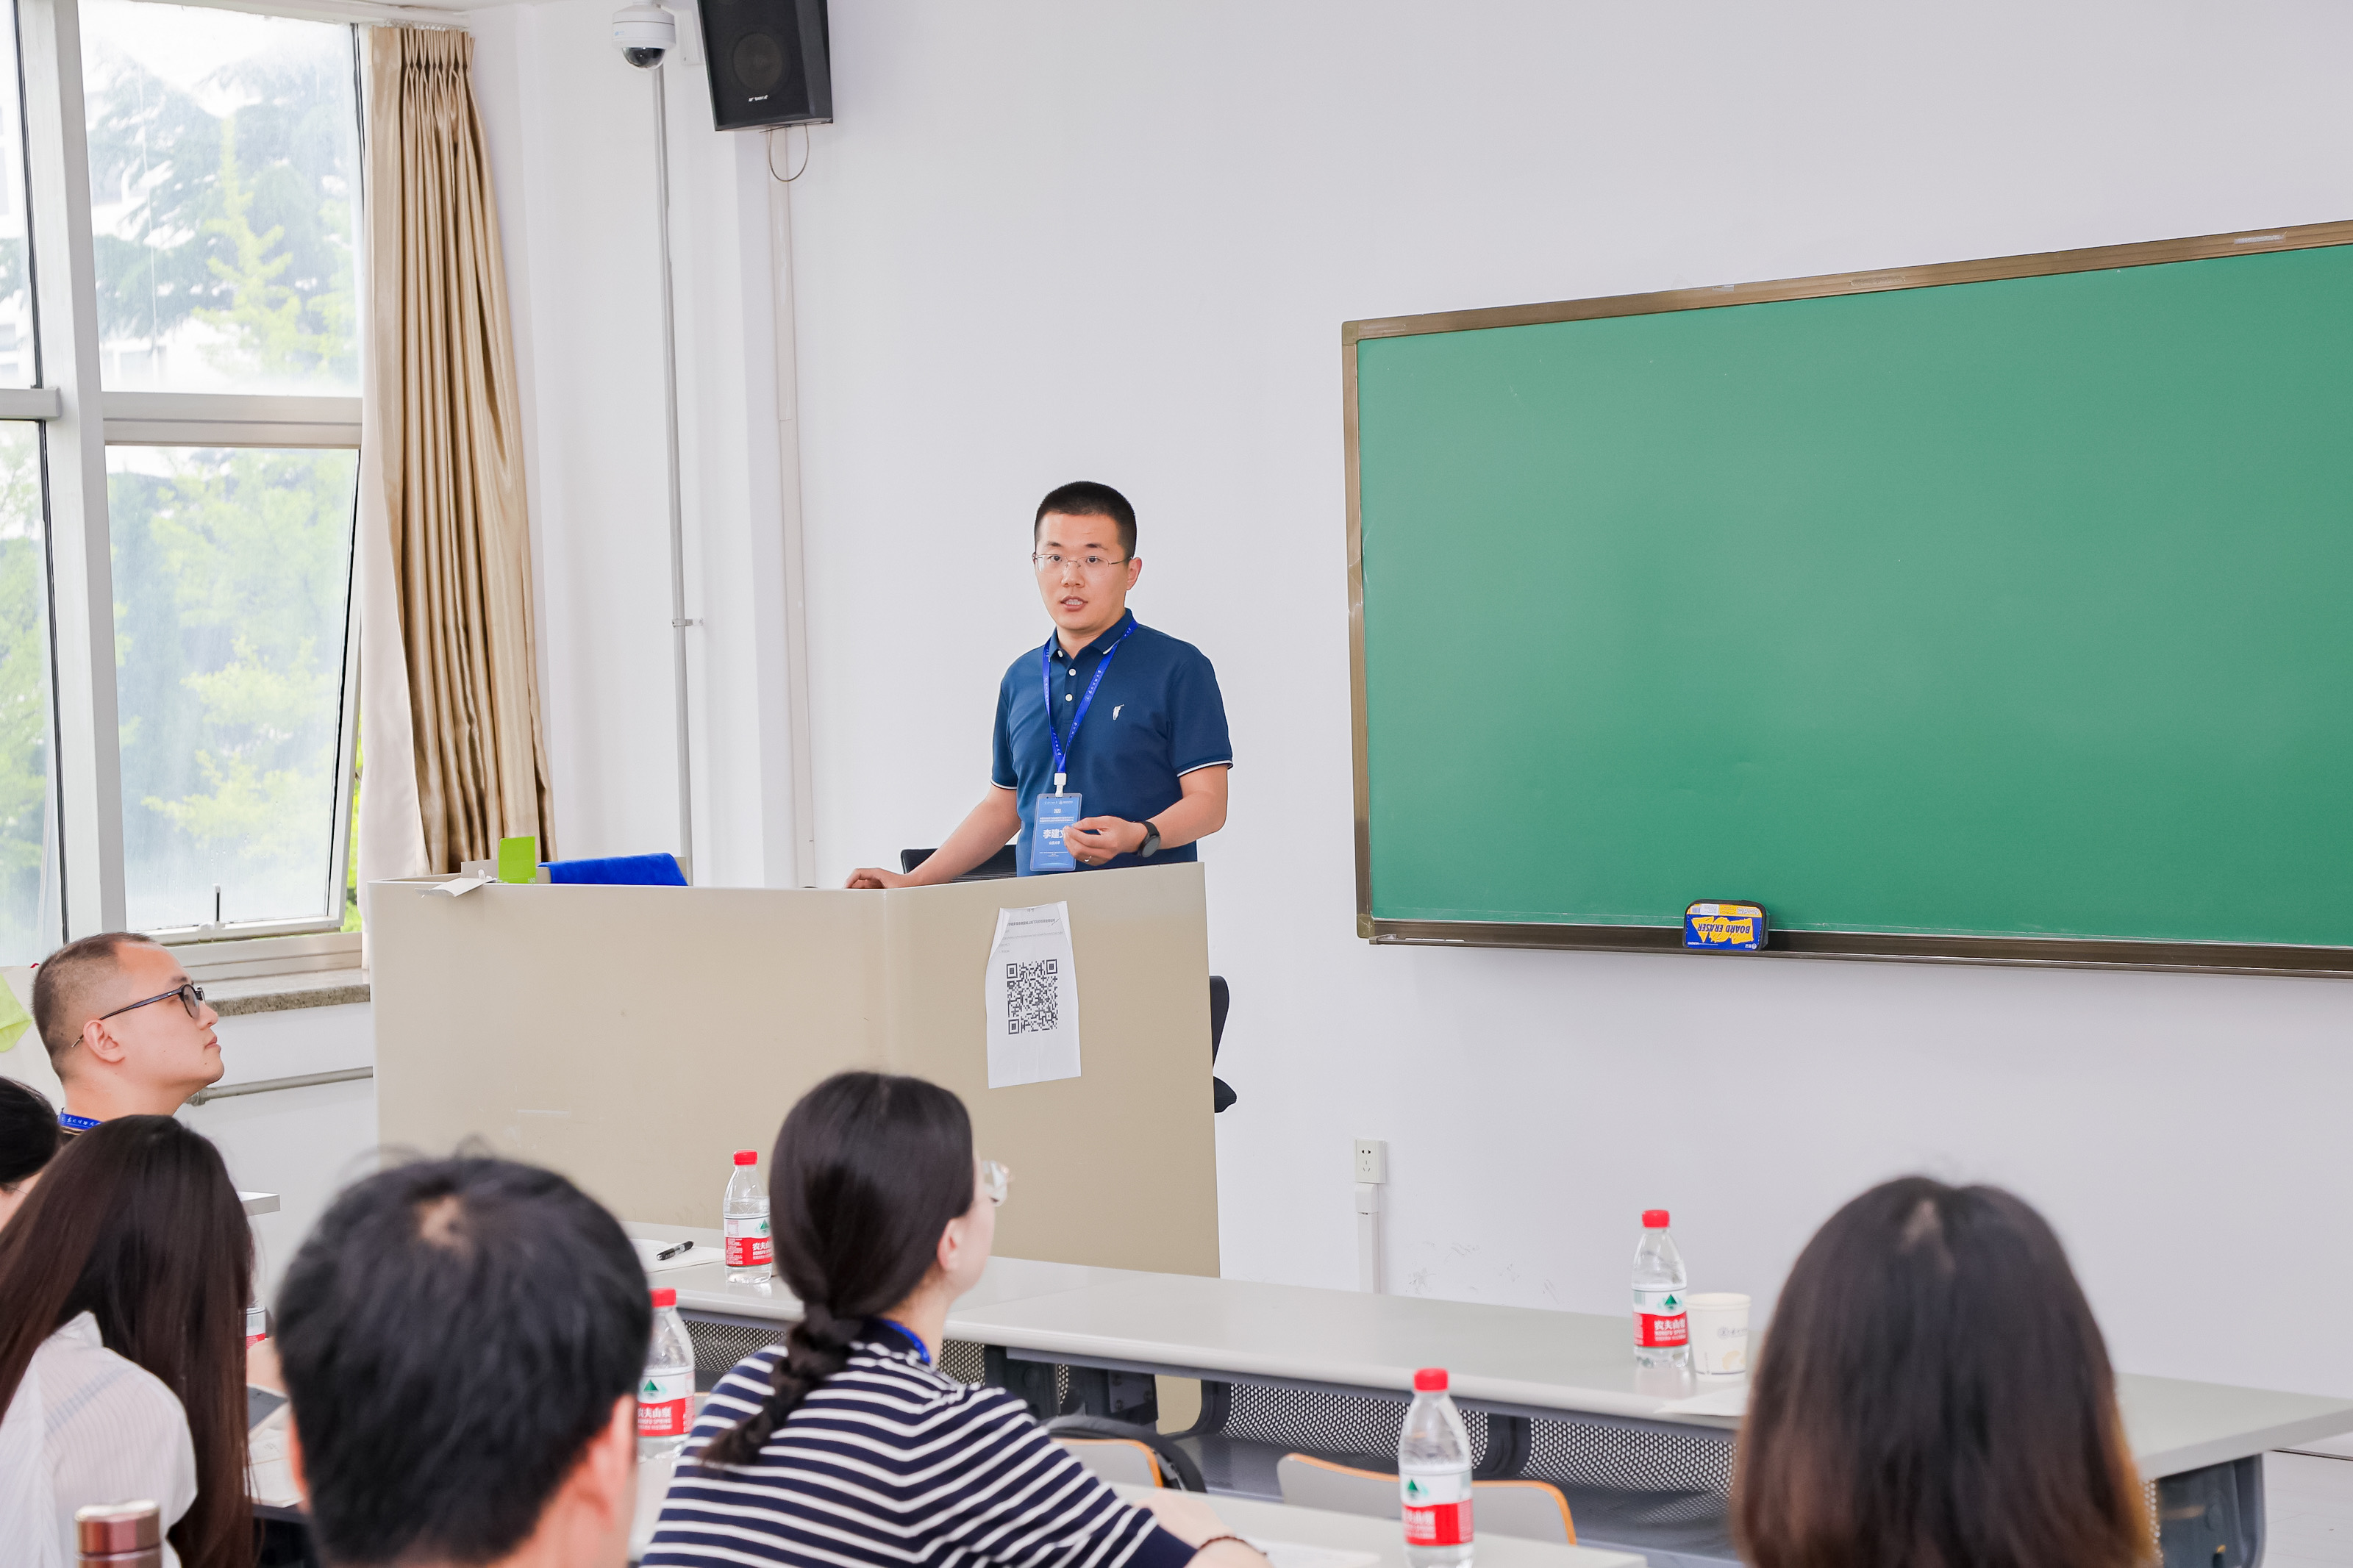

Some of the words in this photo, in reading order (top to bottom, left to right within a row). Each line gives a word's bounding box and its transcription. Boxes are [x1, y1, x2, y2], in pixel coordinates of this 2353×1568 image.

[1697, 923, 1723, 933] ERASER
[1726, 925, 1750, 934] BOARD
[1654, 1318, 1685, 1331] 农夫山泉
